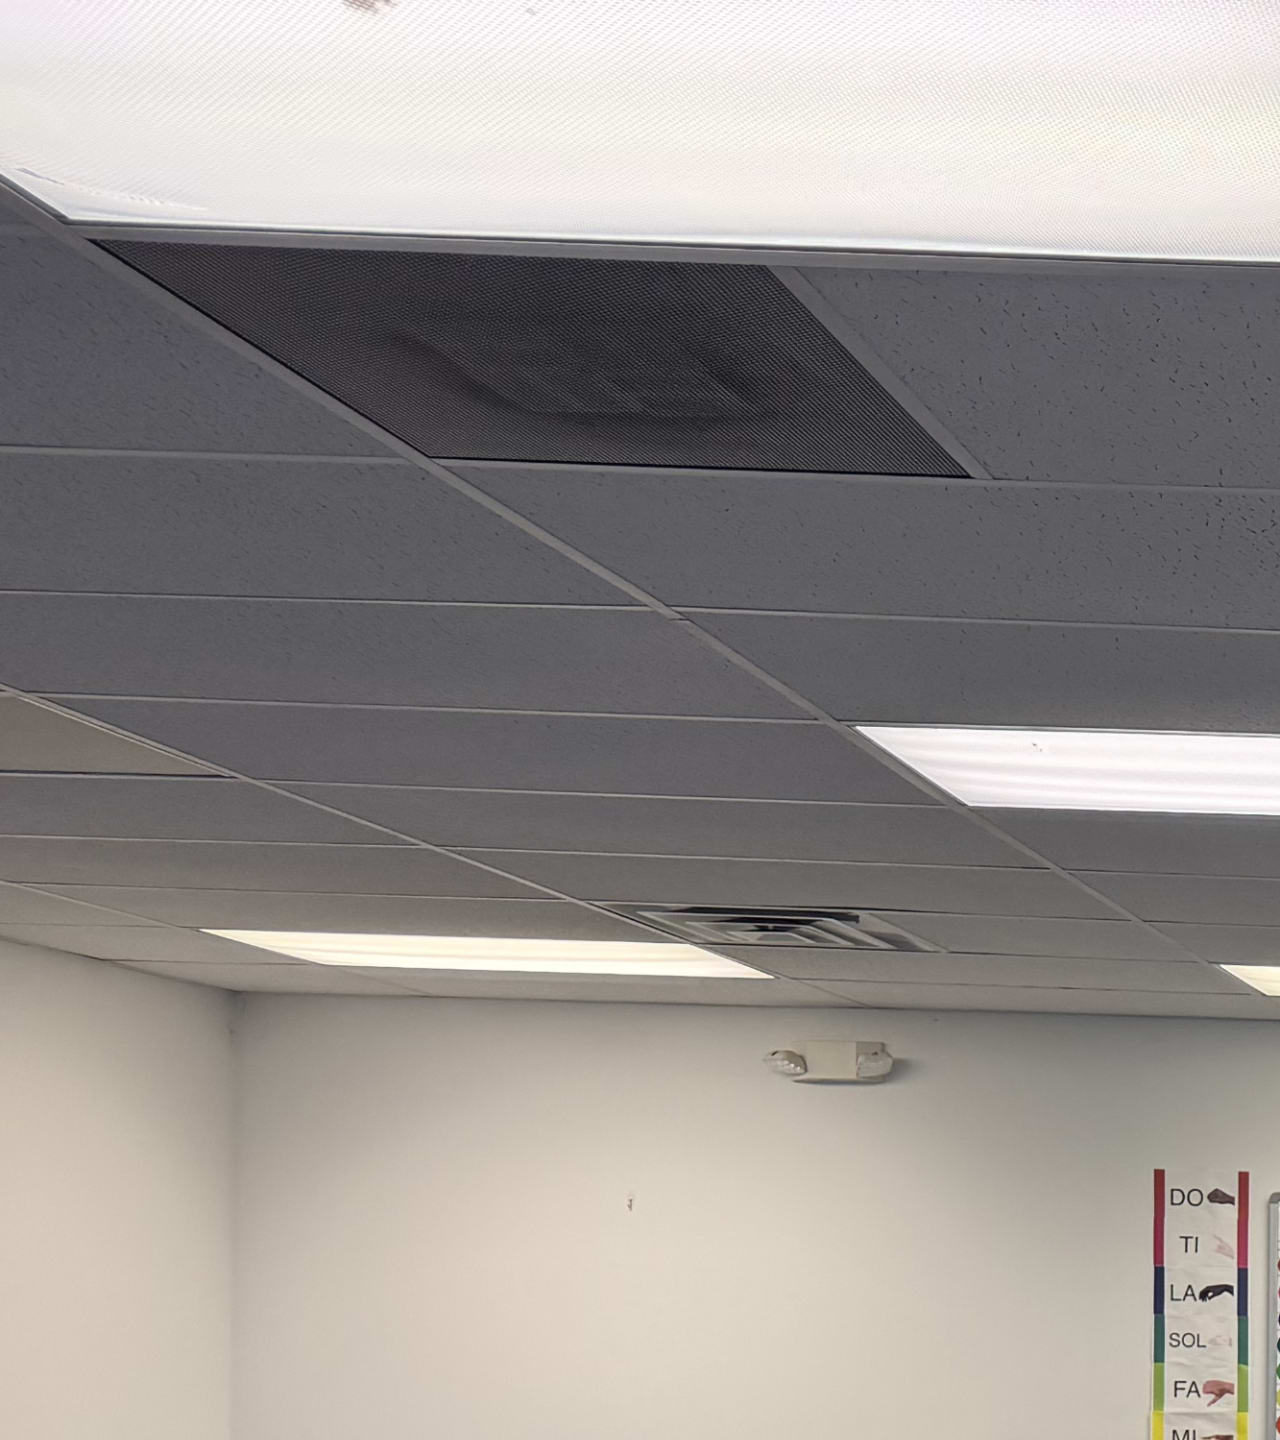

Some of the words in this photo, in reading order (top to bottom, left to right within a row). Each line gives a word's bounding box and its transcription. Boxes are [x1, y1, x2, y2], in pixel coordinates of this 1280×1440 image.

[1170, 1188, 1204, 1206] DO
[1180, 1236, 1199, 1253] TI
[1170, 1285, 1197, 1302] LA
[1169, 1332, 1207, 1348] SOL
[1173, 1381, 1202, 1398] FA
